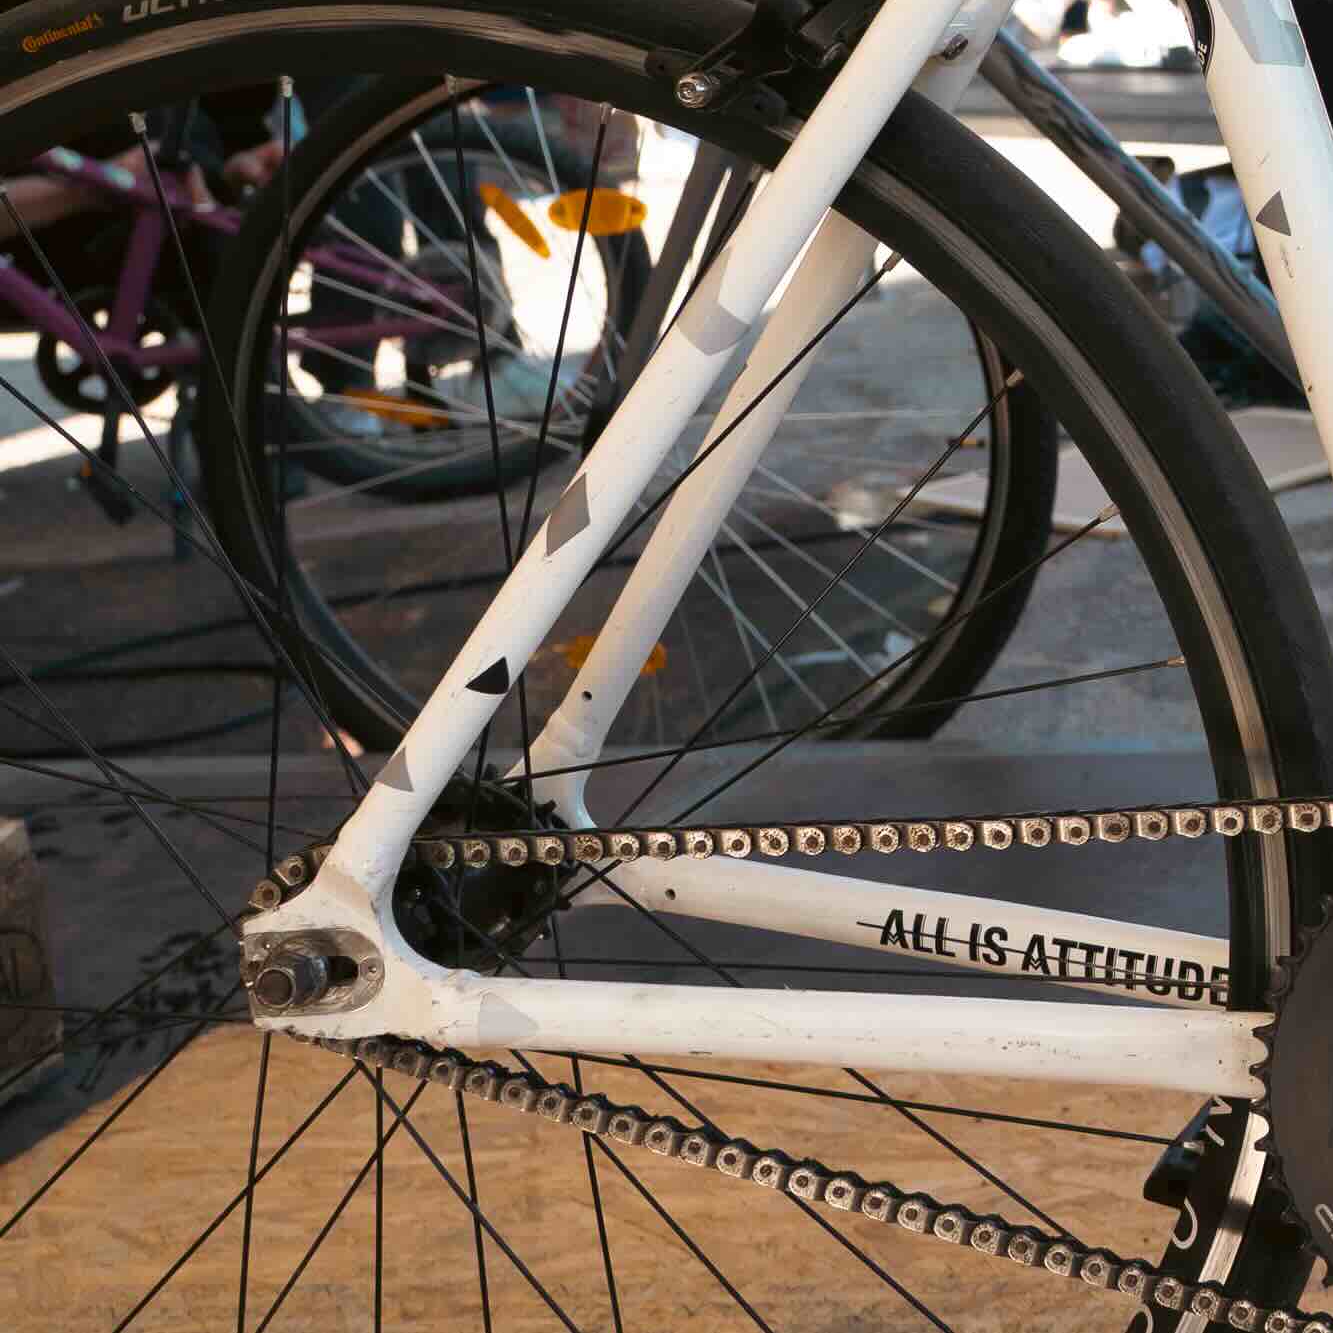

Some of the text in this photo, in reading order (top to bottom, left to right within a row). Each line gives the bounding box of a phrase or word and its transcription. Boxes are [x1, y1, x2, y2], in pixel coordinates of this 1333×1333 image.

[22, 18, 96, 53] Continental
[880, 908, 1231, 1007] ALL IS ATTITUDE
